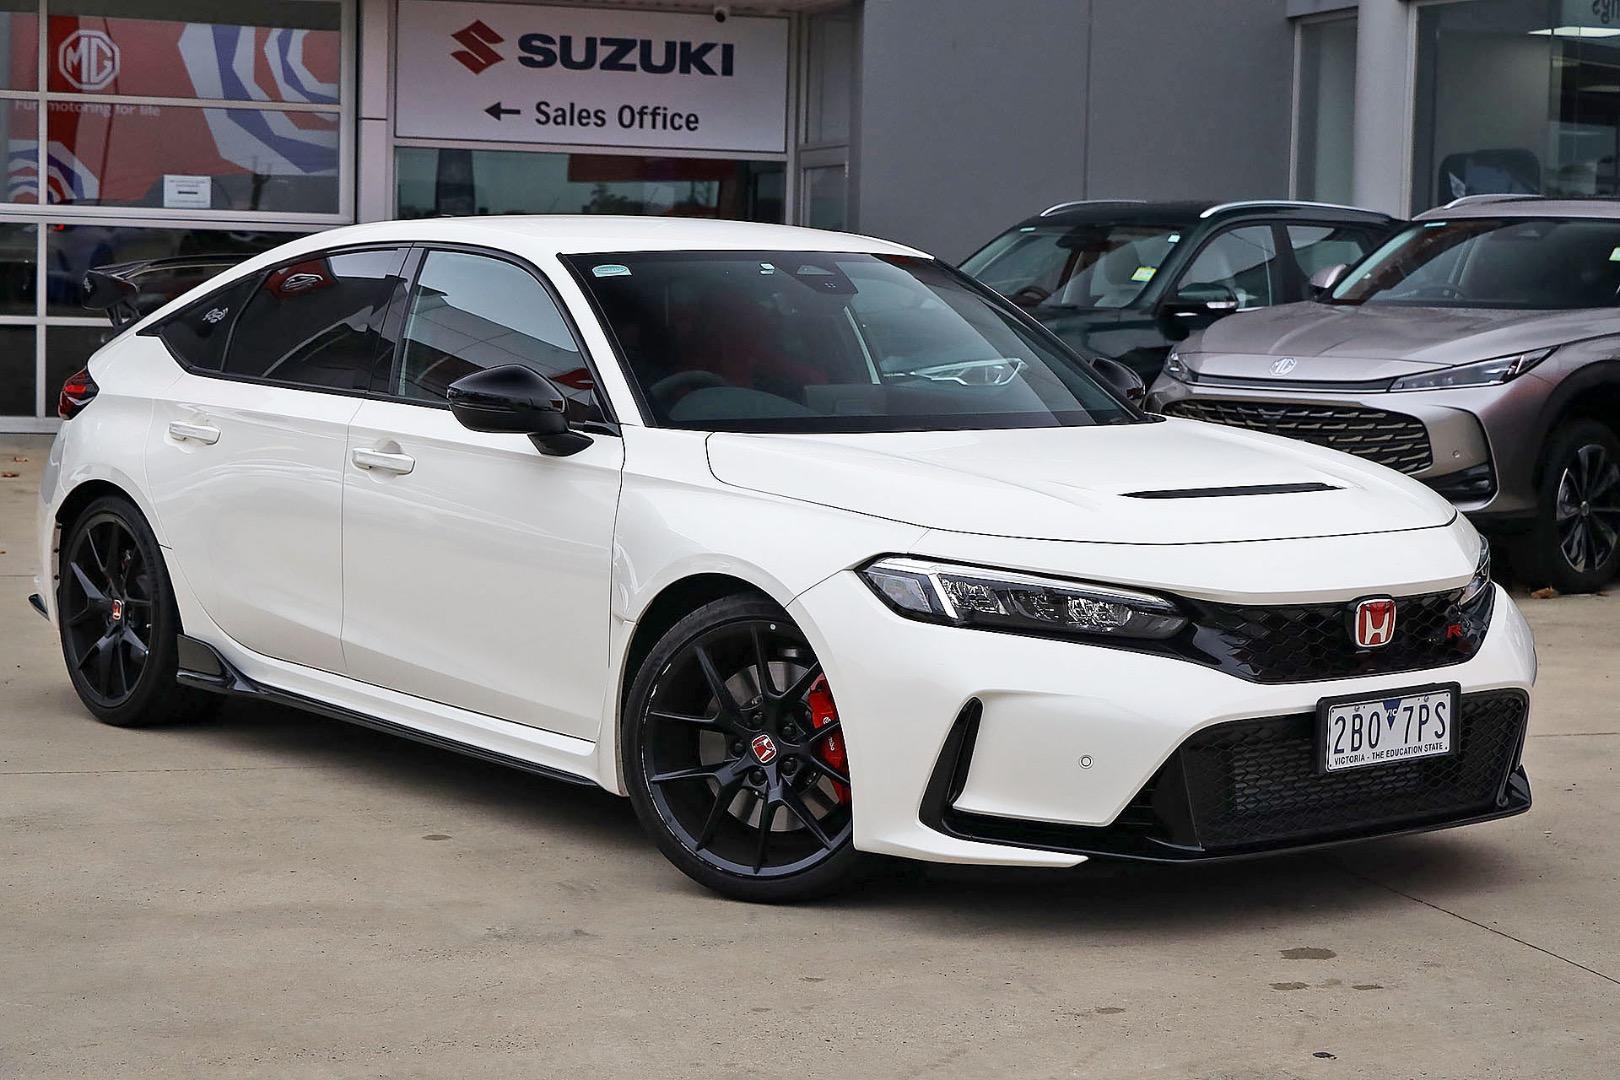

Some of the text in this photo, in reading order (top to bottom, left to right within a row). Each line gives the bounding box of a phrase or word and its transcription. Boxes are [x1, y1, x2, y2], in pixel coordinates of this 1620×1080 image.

[64, 35, 114, 83] MG
[517, 33, 734, 76] SUZUKI
[535, 101, 699, 131] Sales Office
[1403, 701, 1446, 744] 7PS
[1334, 755, 1365, 765] VICTORIA
[1372, 752, 1384, 761] THE
[1385, 745, 1423, 757] EDUCATION
[1424, 742, 1443, 753] STATE
